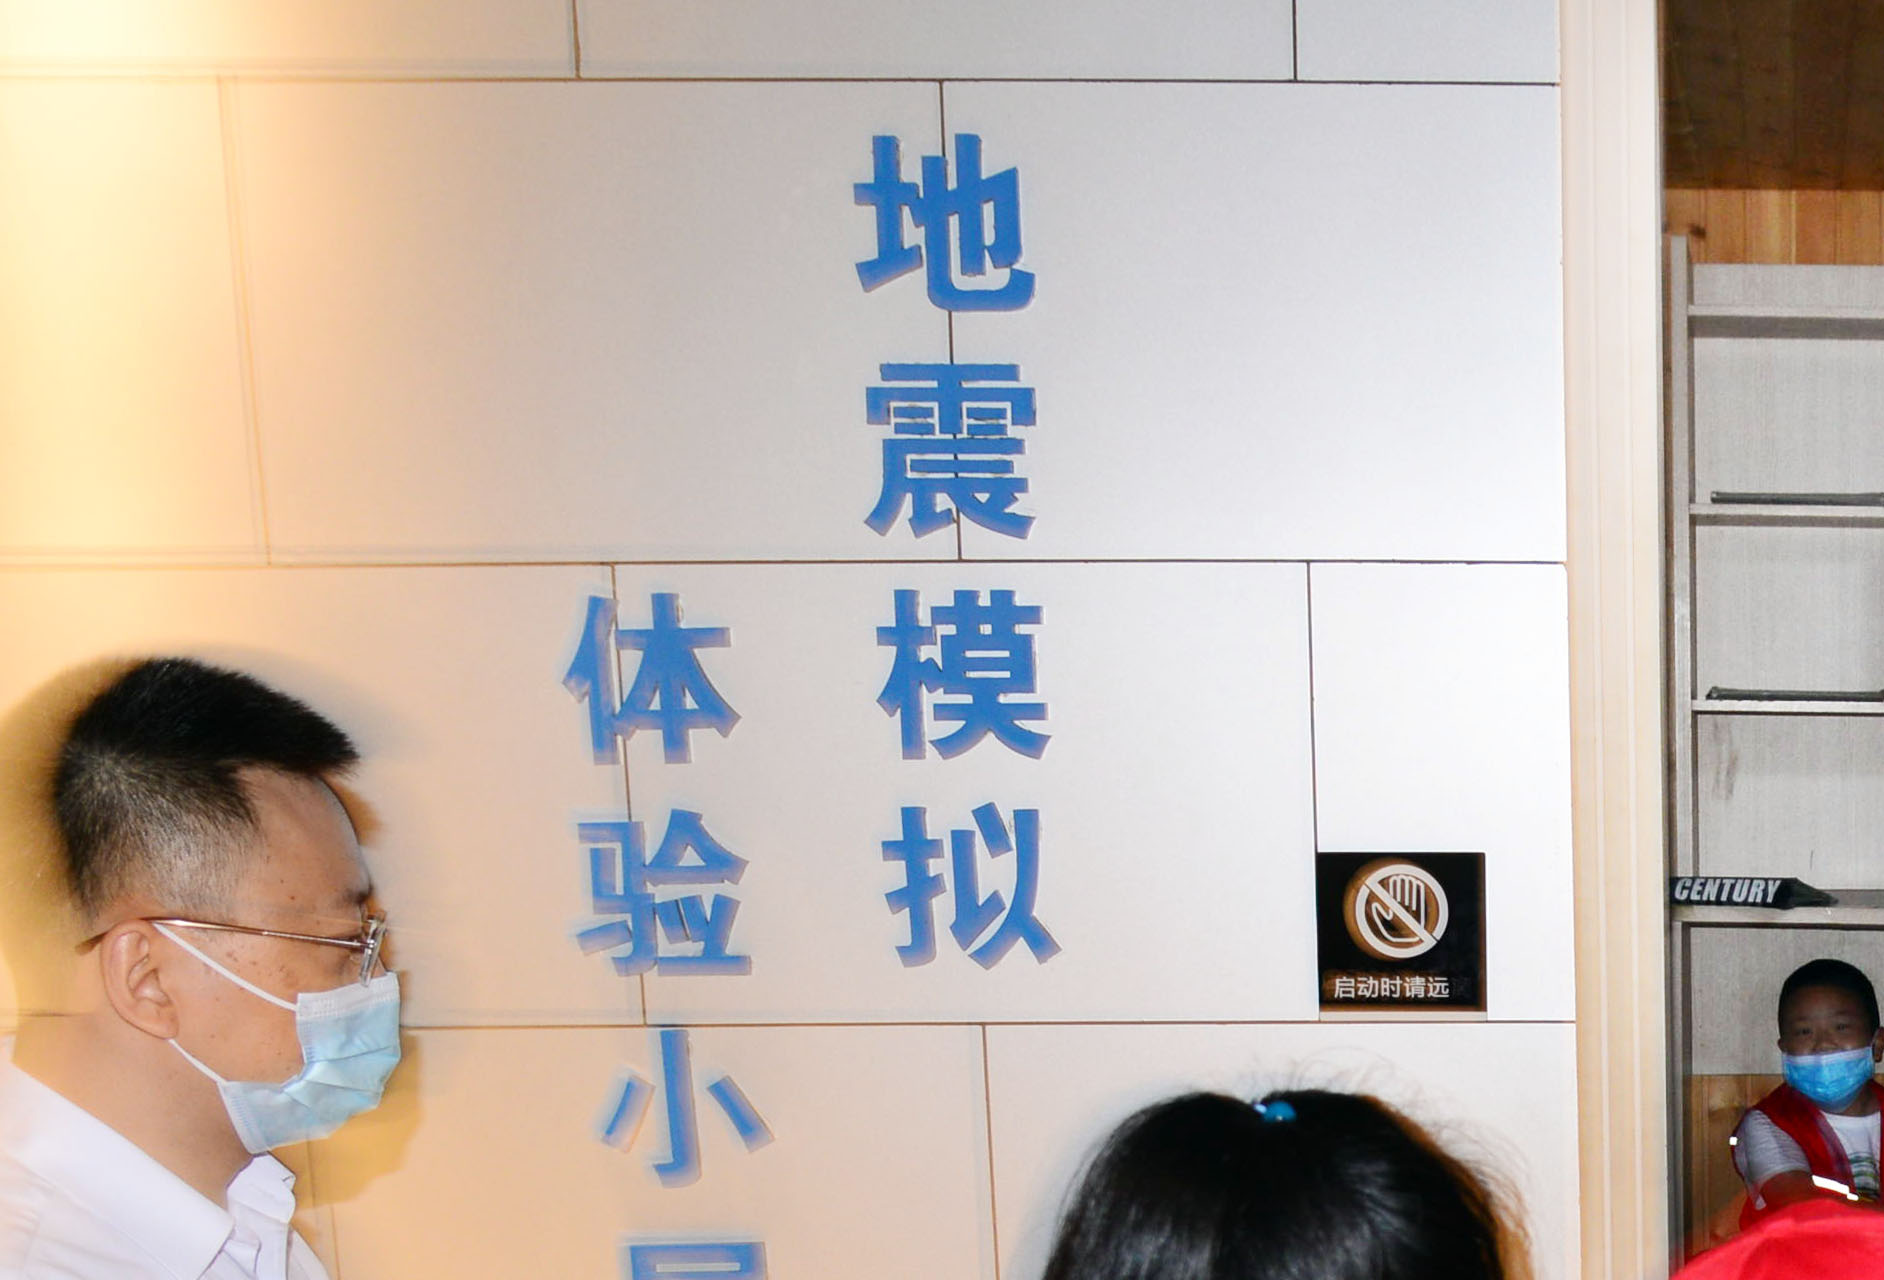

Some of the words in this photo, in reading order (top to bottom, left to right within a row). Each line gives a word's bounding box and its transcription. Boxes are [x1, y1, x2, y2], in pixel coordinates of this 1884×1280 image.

[853, 133, 1062, 970] 地震模拟
[1674, 878, 1781, 903] CENTURY
[1334, 976, 1471, 999] 启动时请远
